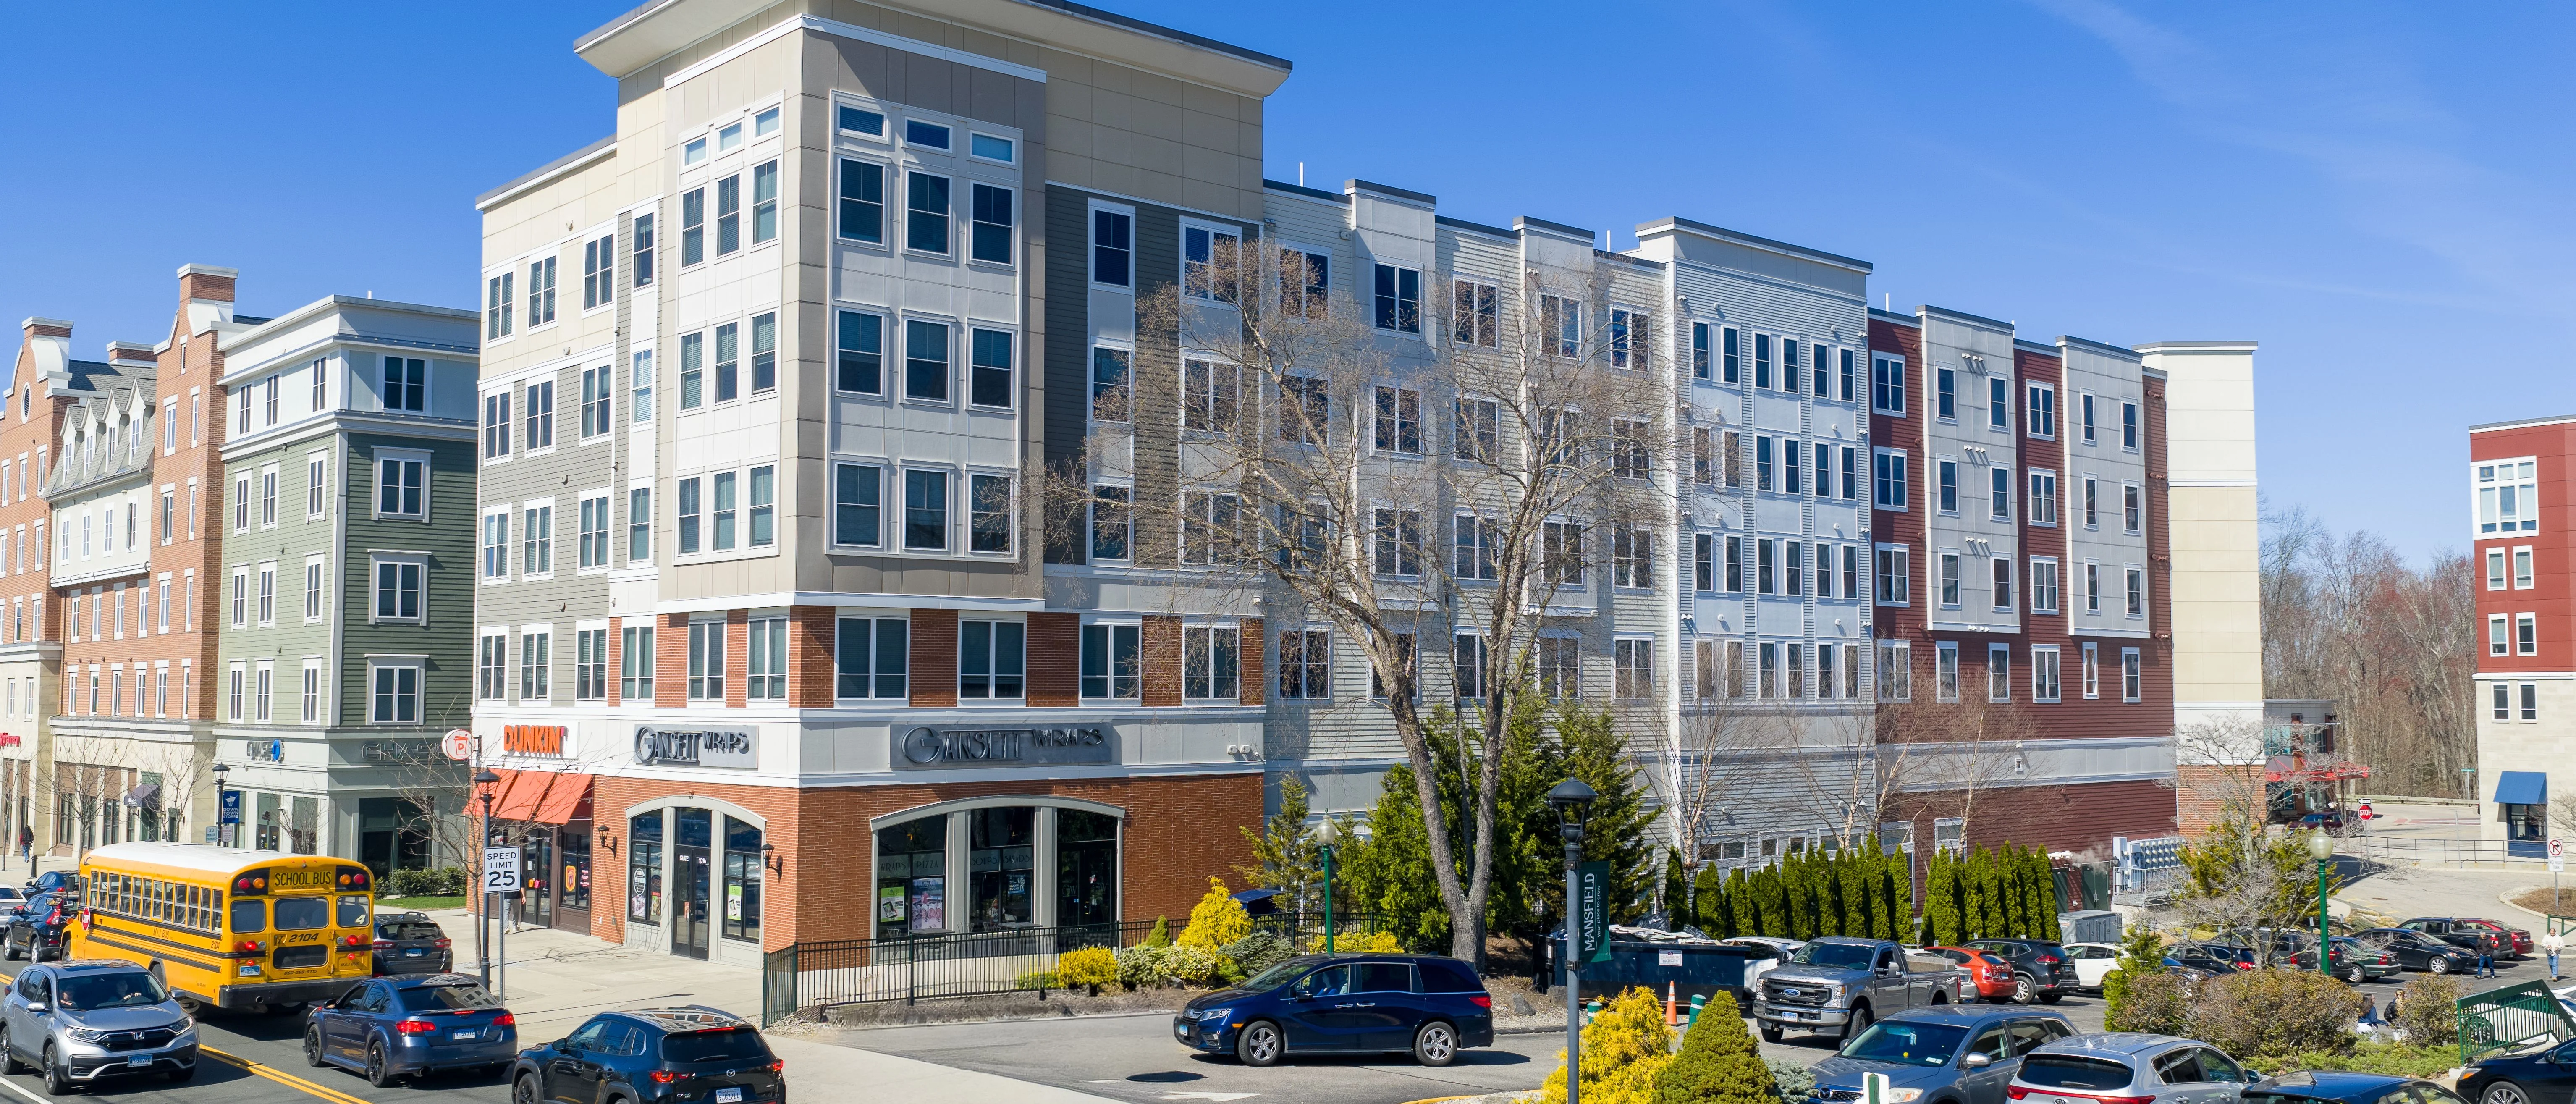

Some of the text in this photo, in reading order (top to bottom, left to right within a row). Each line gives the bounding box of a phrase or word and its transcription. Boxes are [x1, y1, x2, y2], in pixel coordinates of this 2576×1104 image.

[504, 725, 564, 754] DUNKIN'
[634, 727, 749, 763] GANSETT WRAPS
[901, 726, 1104, 763] GANSETT WRAPS
[916, 860, 939, 869] PIZZA
[970, 857, 997, 865] SOUPS
[880, 863, 906, 872] WRAPS
[275, 871, 331, 886] SCHOOL BUS
[488, 871, 515, 887] 25
[1584, 873, 1595, 951] MANSFIELD
[355, 914, 366, 924] 4
[288, 933, 319, 943] 2104
[211, 941, 220, 949] 2104
